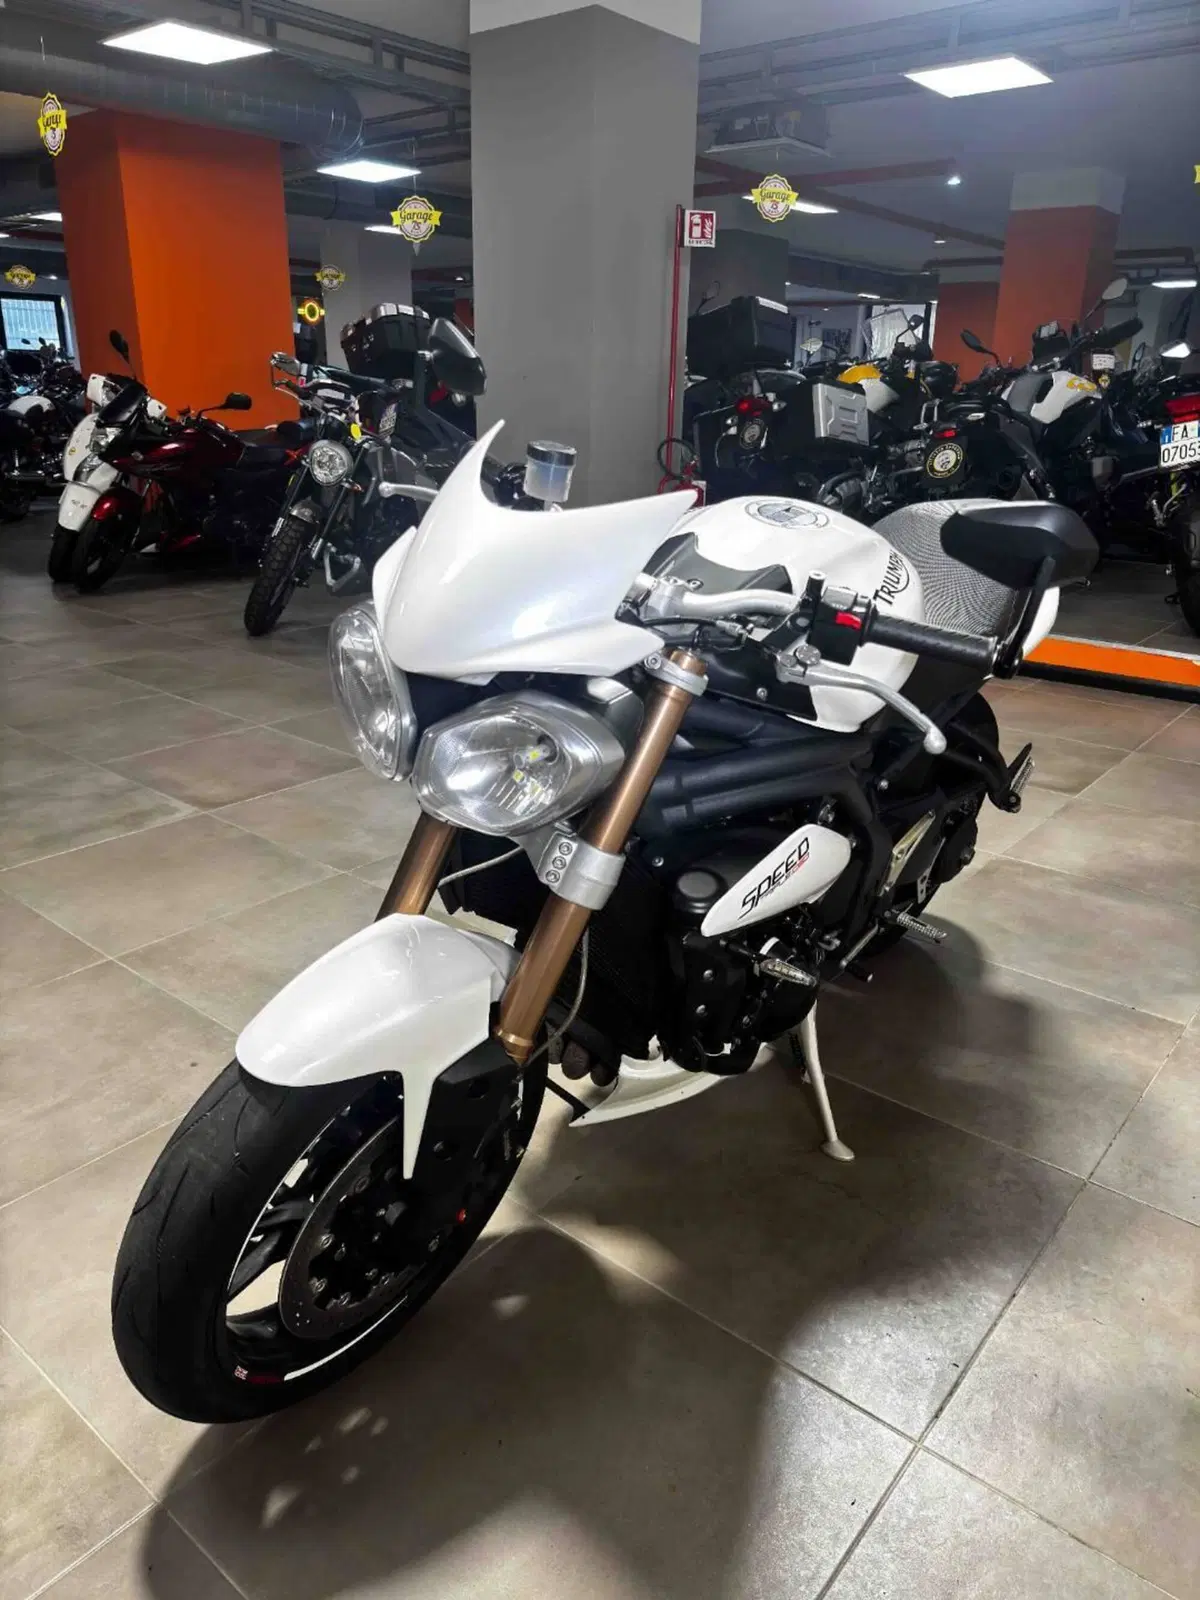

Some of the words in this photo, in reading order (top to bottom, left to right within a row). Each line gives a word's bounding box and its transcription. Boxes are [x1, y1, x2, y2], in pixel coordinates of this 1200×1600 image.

[760, 189, 790, 203] Garage
[400, 210, 433, 223] Garage
[1173, 424, 1189, 440] FA
[738, 837, 810, 920] SPEED
